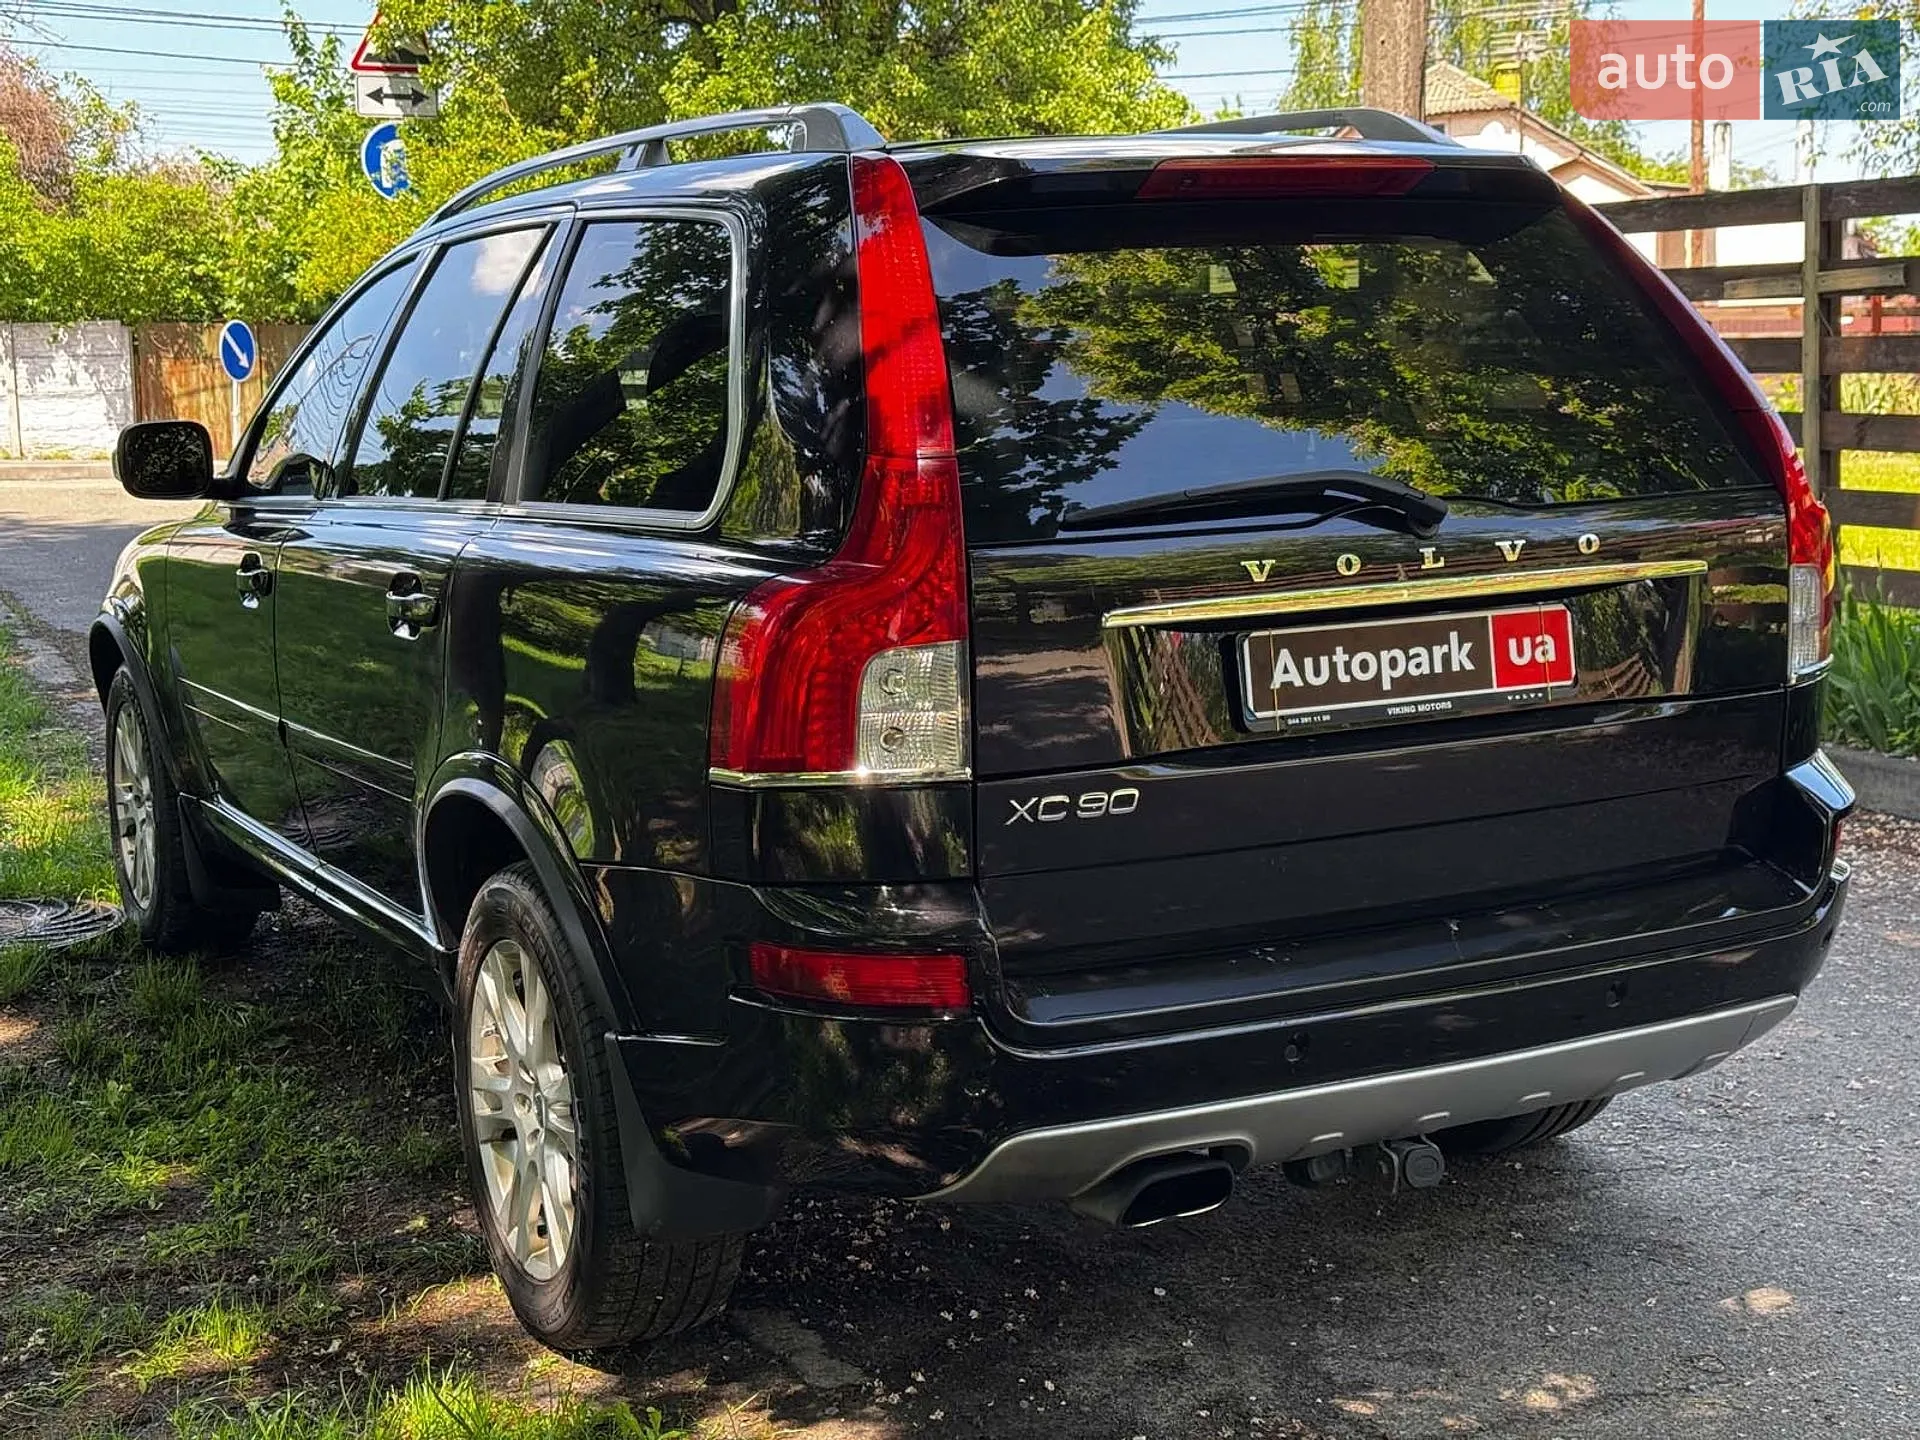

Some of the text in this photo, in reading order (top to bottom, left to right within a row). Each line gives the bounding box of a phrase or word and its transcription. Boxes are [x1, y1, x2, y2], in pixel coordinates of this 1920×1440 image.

[1240, 532, 1601, 583] VOLVO
[1271, 630, 1557, 691] Autopark ua
[1387, 701, 1453, 716] VIKING MOTORS
